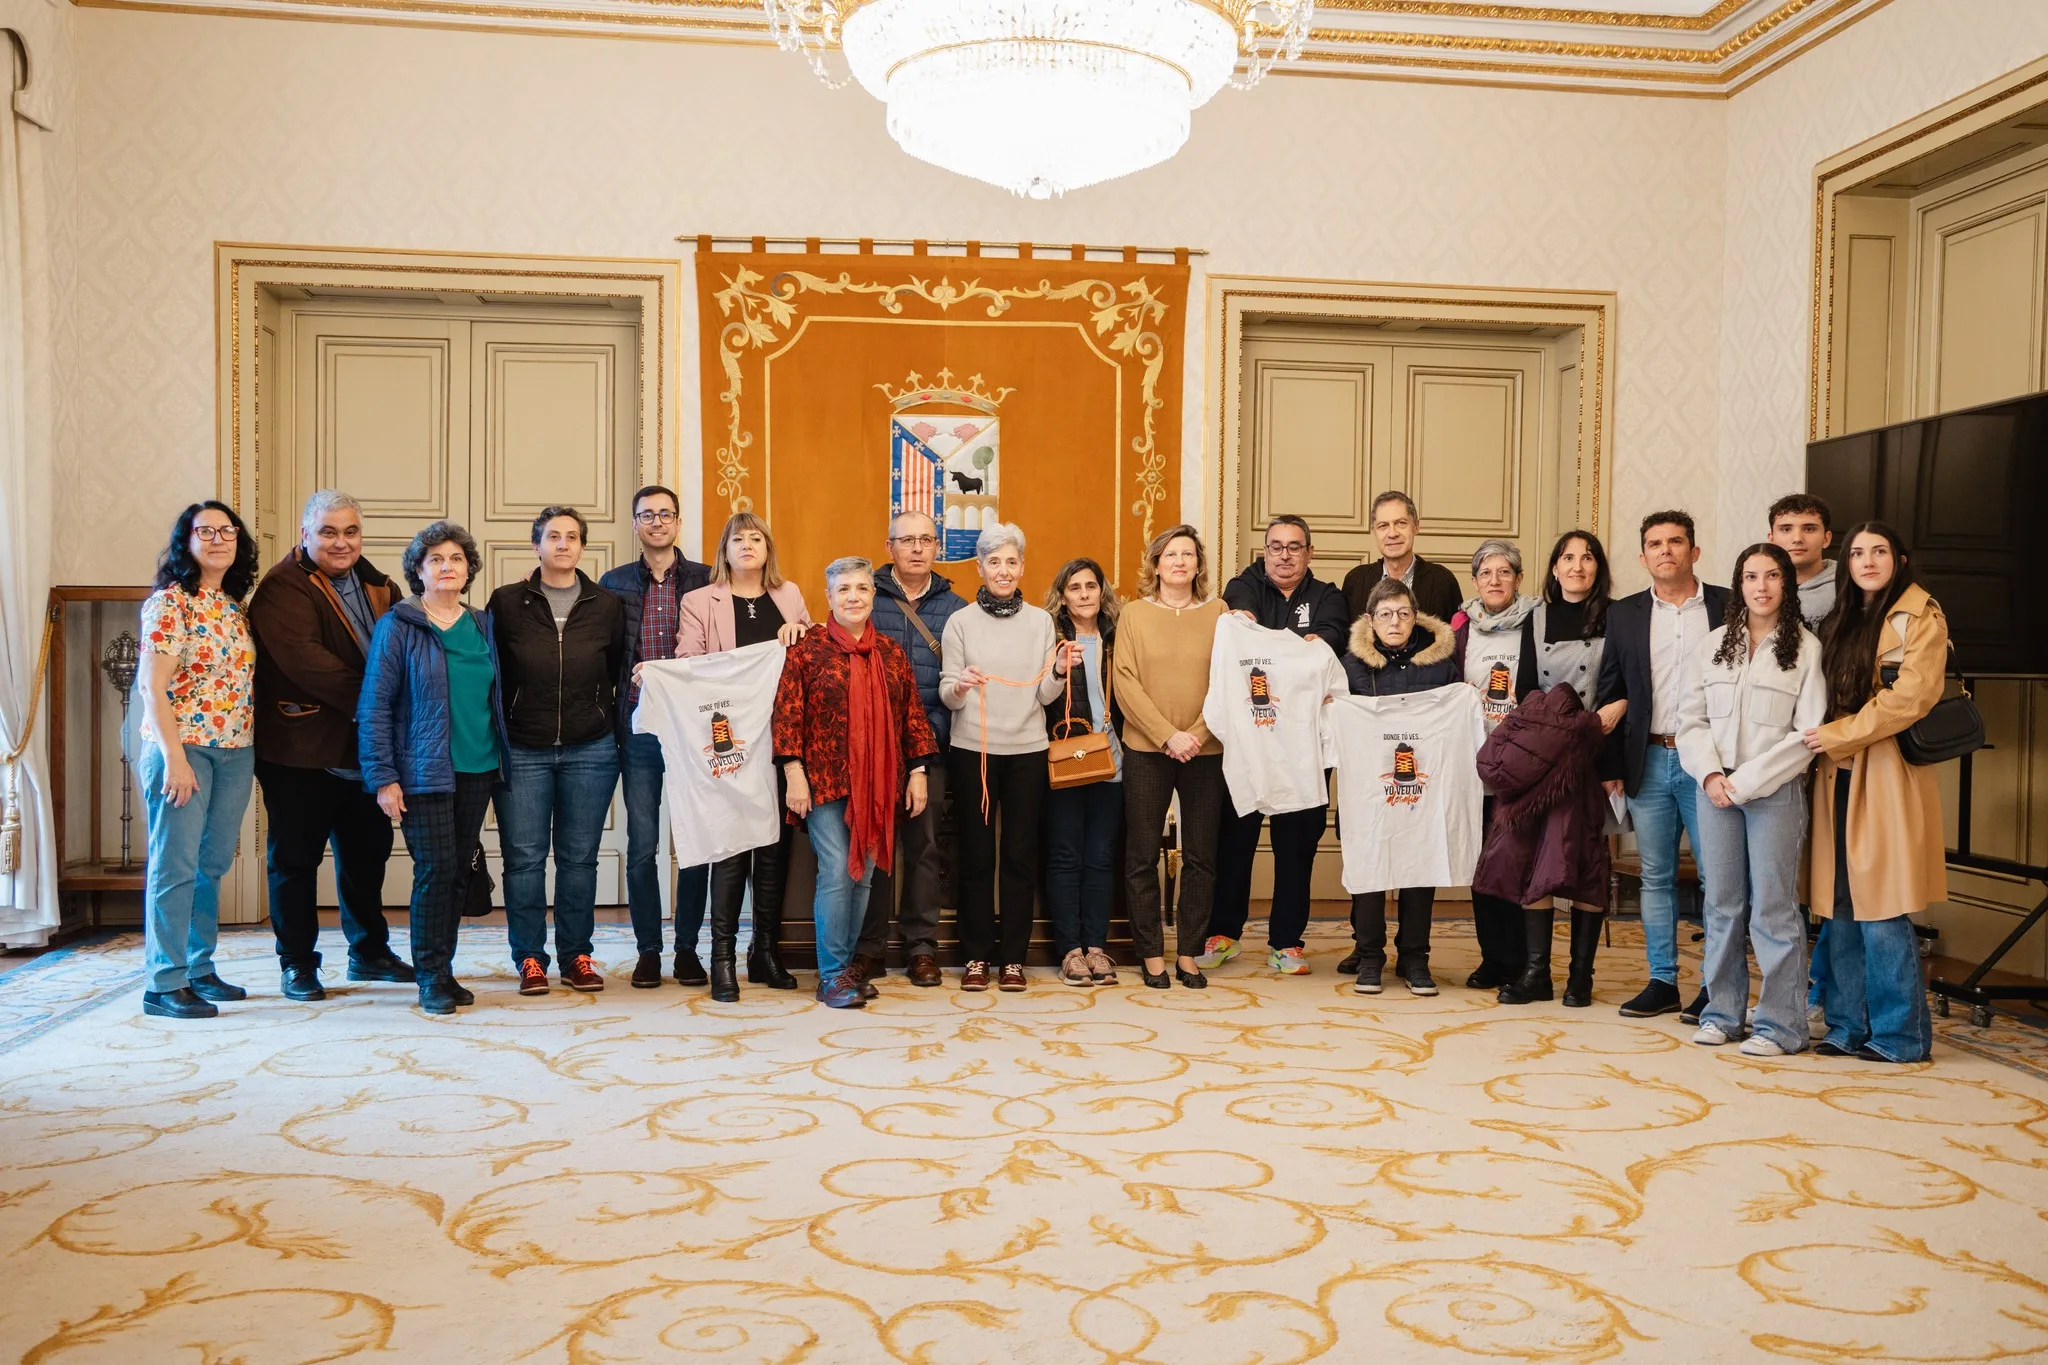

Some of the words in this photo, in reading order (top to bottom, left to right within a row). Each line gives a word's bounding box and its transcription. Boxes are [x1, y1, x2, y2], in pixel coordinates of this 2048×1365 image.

[698, 703, 714, 713] DONDE
[1487, 702, 1503, 713] VEO
[1383, 733, 1401, 741] DONDE
[1401, 731, 1408, 741] TÚ
[707, 758, 717, 769] YO
[717, 755, 733, 767] VEO
[732, 752, 745, 763] UN
[1384, 785, 1395, 796] YO
[1396, 785, 1411, 795] VEO
[1411, 785, 1423, 795] UN
